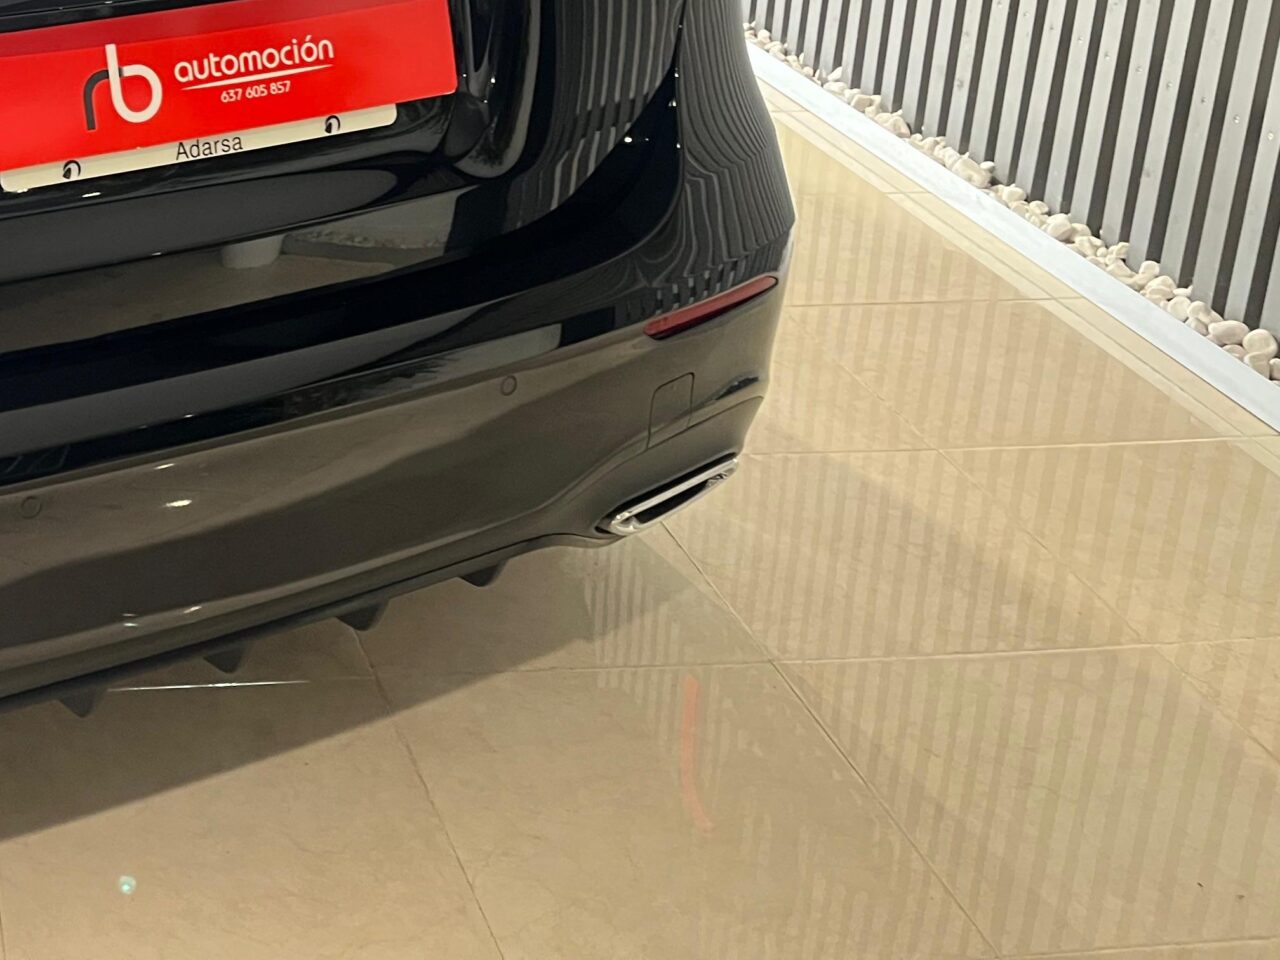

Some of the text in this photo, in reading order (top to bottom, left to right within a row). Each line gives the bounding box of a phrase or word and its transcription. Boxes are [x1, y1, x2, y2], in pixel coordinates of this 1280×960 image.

[173, 34, 335, 84] automoción
[83, 43, 163, 131] rb
[220, 80, 292, 103] 637 605 857
[176, 136, 244, 161] Adarsa
